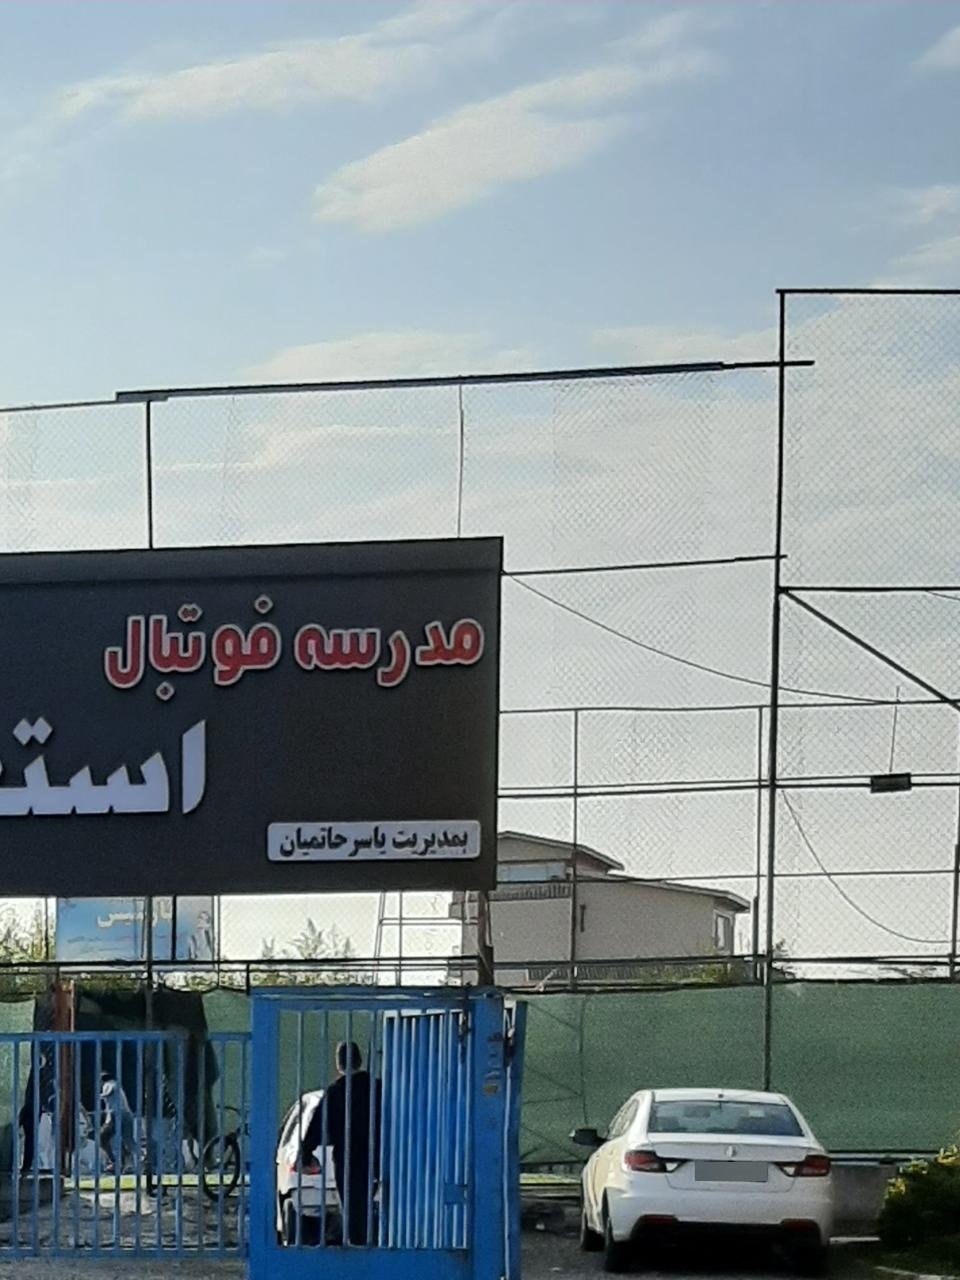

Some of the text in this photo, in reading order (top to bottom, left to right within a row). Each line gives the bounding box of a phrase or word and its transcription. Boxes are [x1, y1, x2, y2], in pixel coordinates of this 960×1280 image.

[104, 594, 485, 701] مدرسه فوتبال
[348, 826, 387, 857] یاسر
